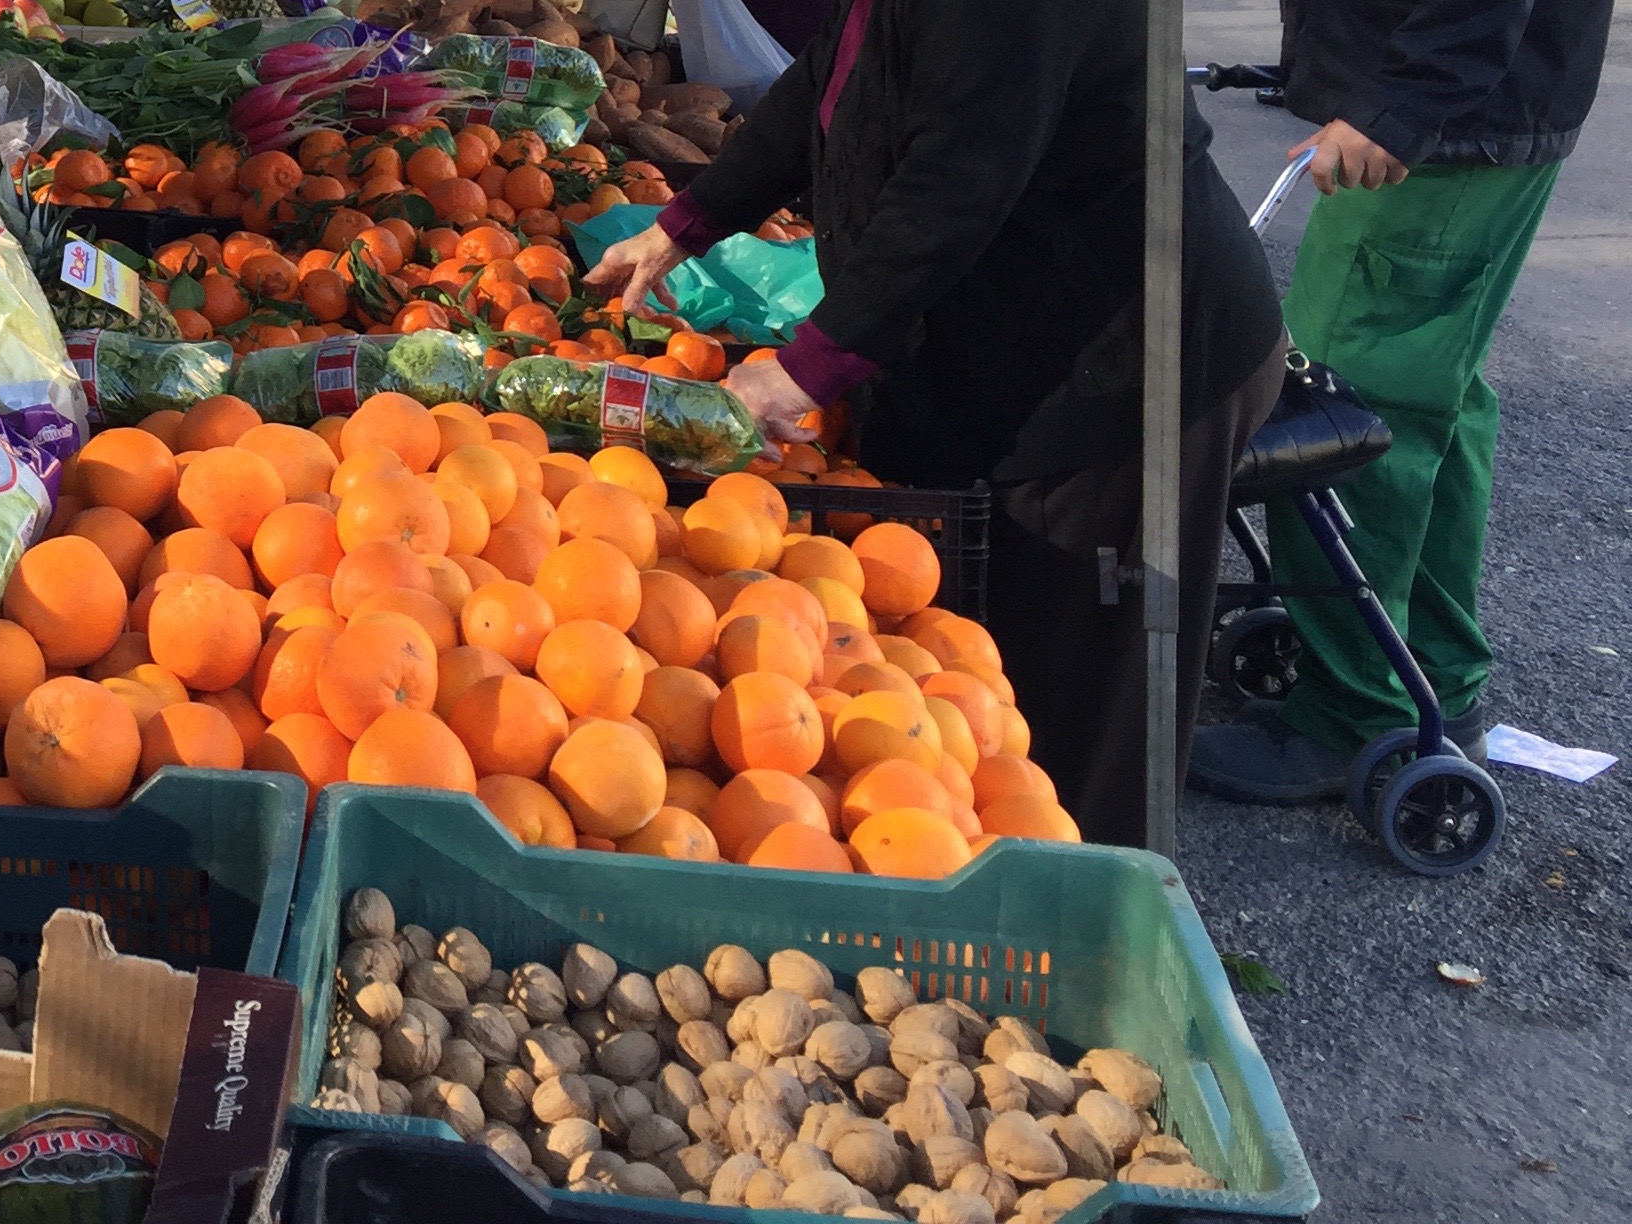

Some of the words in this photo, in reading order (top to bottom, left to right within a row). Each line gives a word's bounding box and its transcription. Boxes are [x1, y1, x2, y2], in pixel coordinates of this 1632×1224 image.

[69, 246, 86, 281] Dole
[223, 999, 262, 1074] Supreme
[205, 1075, 249, 1133] Quality
